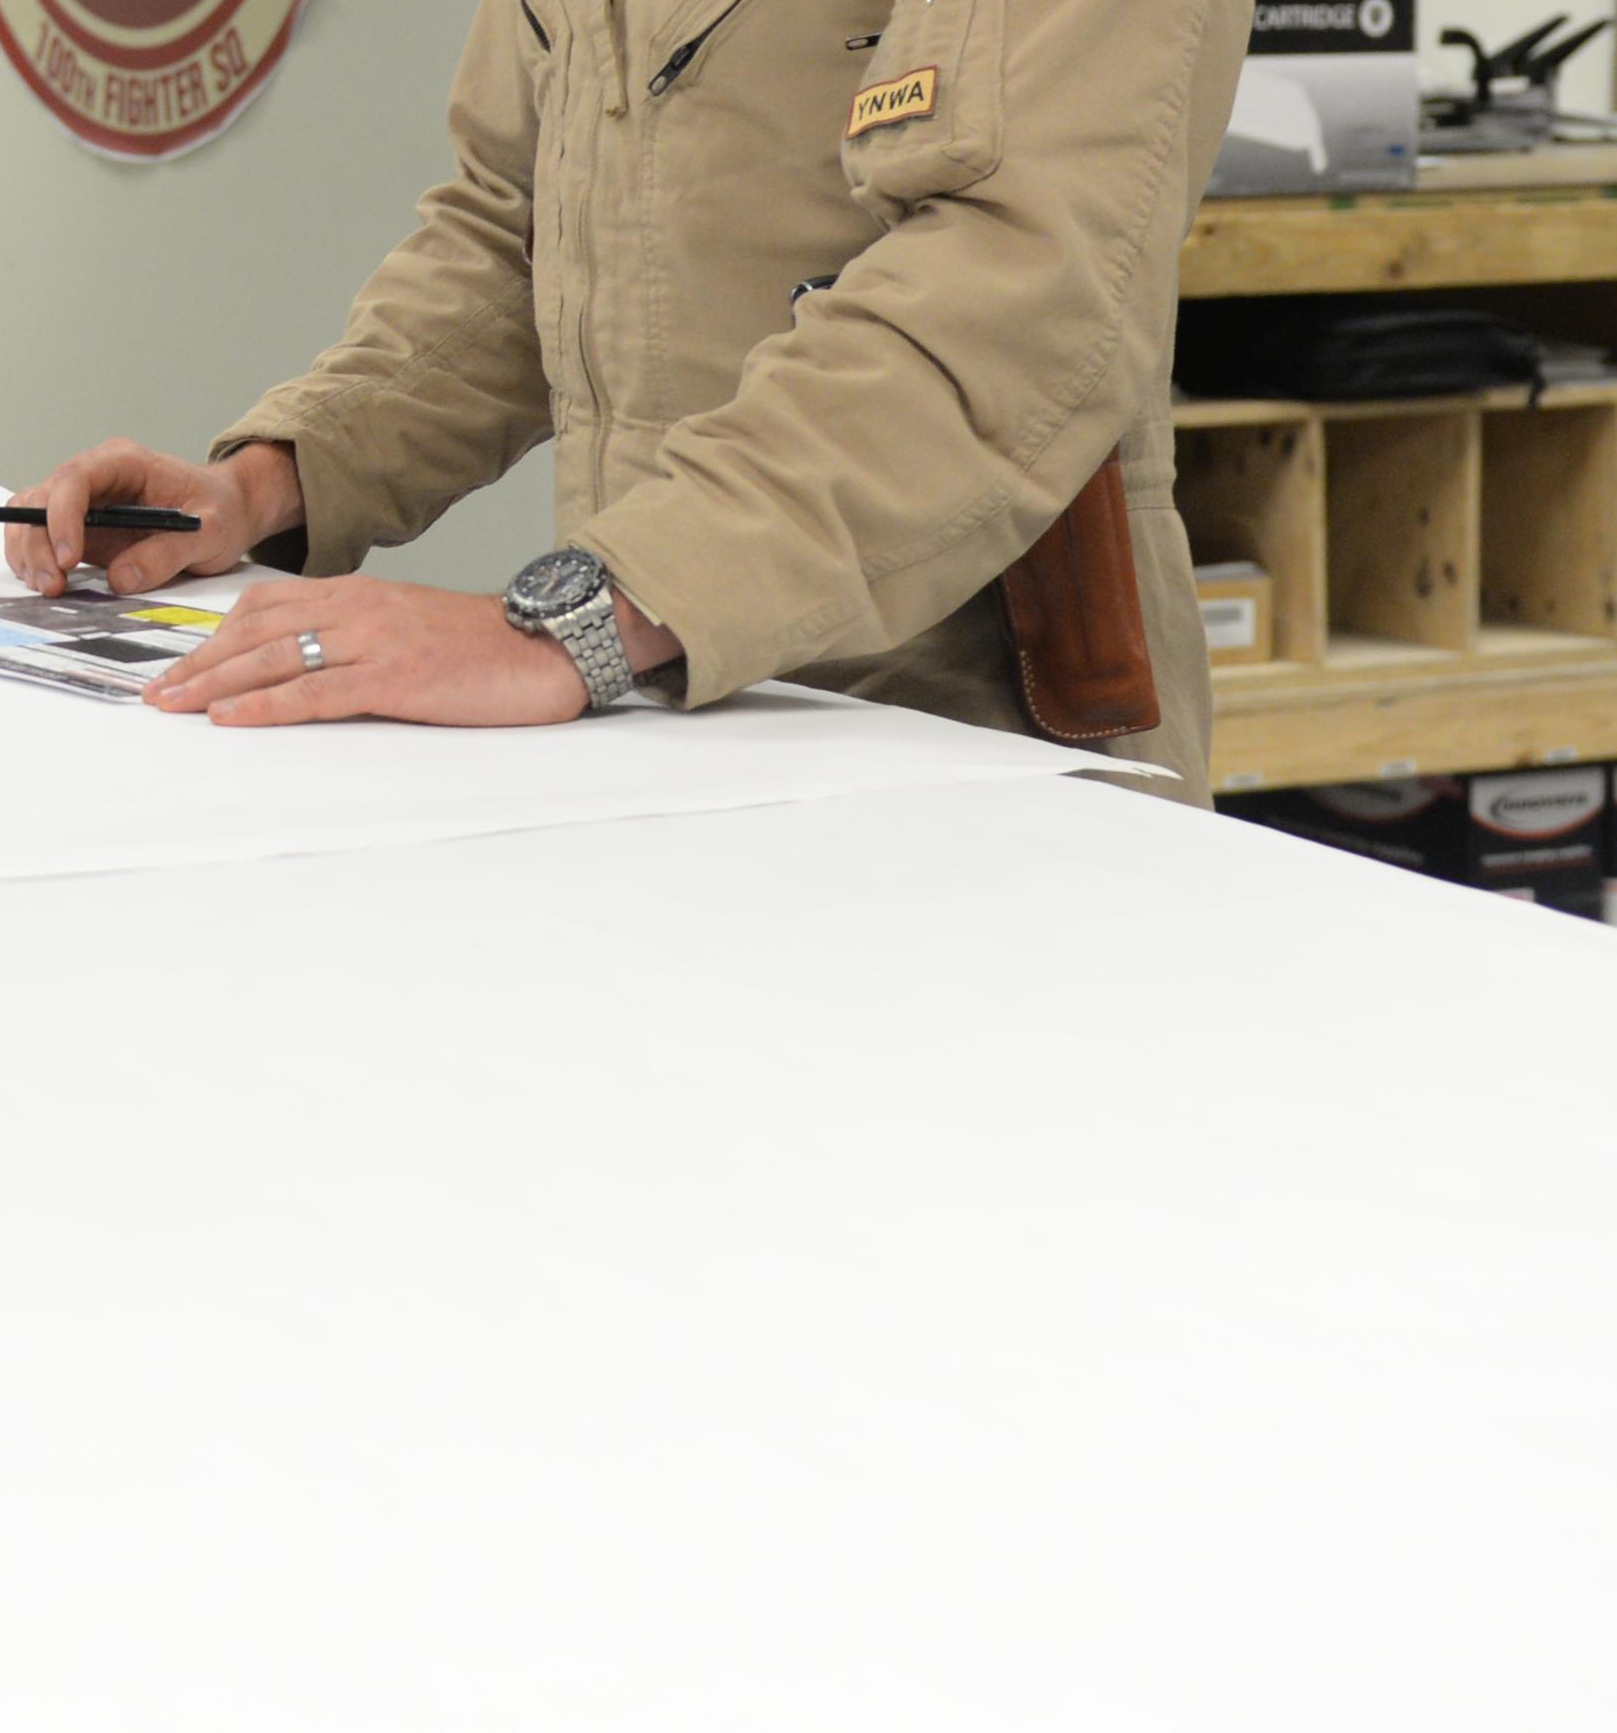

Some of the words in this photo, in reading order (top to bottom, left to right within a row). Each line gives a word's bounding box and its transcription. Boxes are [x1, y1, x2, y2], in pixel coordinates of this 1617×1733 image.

[1253, 2, 1358, 31] CARTRIDGE
[102, 60, 209, 127] FIGHTER
[858, 80, 925, 122] YNWA
